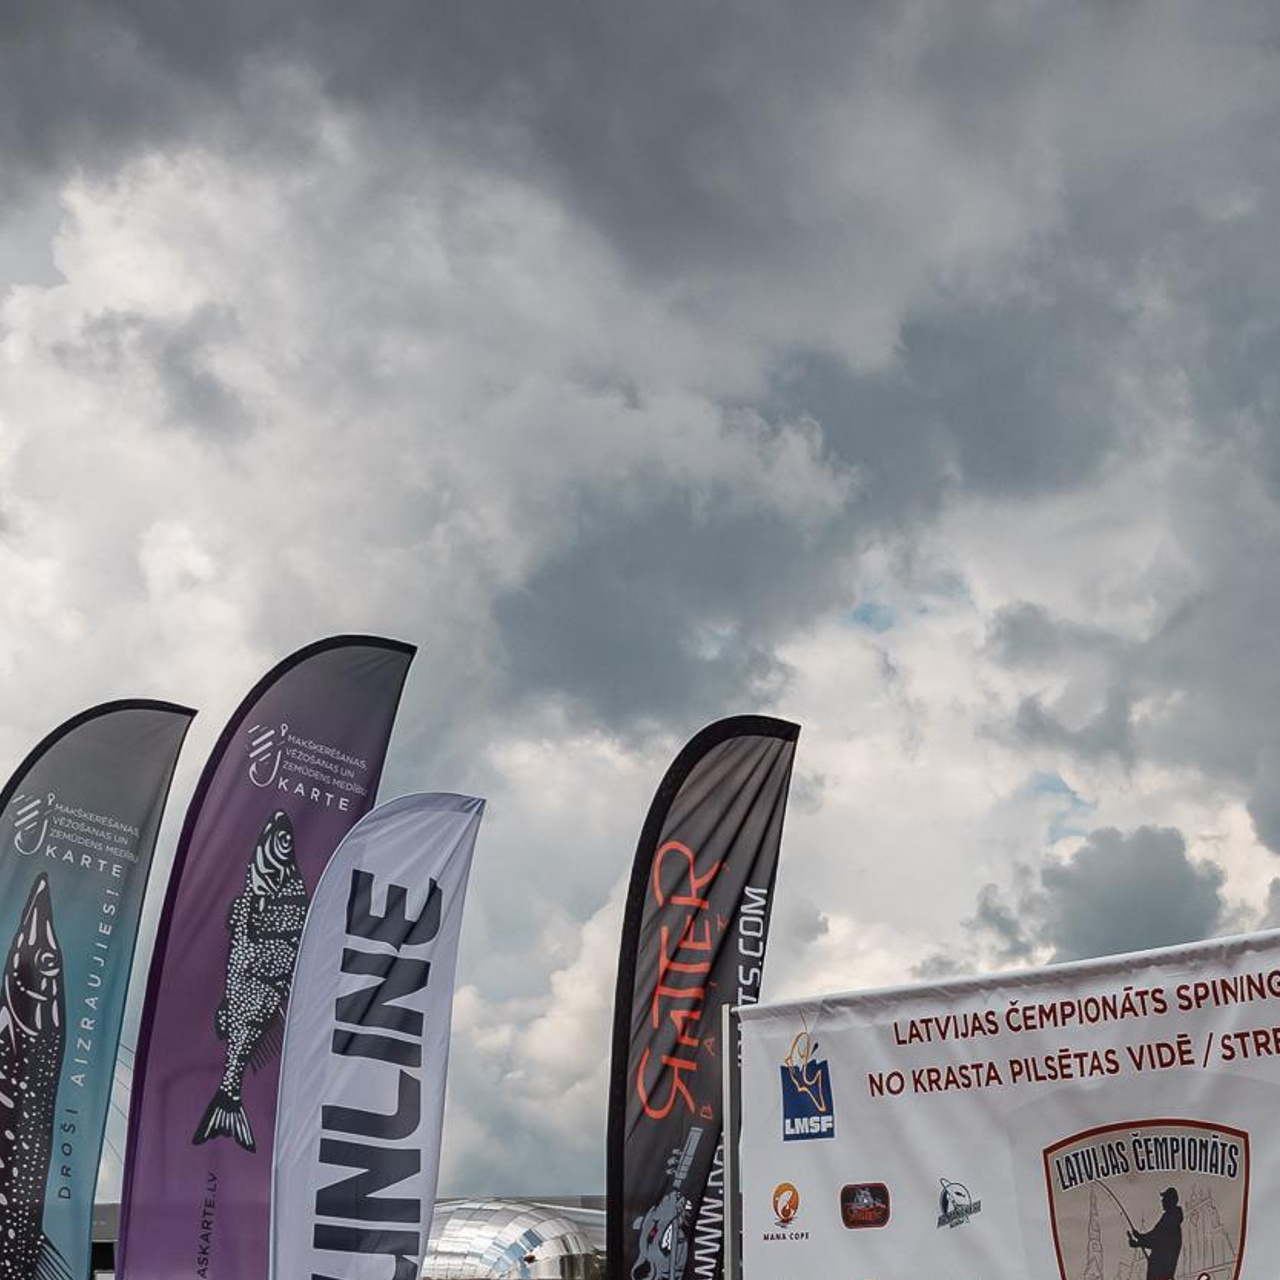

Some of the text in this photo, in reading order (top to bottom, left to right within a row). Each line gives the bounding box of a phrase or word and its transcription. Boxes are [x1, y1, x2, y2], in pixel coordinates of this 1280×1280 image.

[278, 777, 350, 811] KARTE
[45, 844, 123, 878] KARTE
[58, 887, 120, 1200] DROŠI AIZRAUJIES!
[893, 1007, 1000, 1047] LATVIJAS
[1004, 985, 1170, 1034] ČEMPIONĀTS
[868, 1071, 907, 1098] NO
[911, 1062, 1003, 1094] KRASTA
[1009, 1048, 1121, 1086] PILSĒTAS
[1126, 1034, 1196, 1074] VIDĒ
[784, 1115, 834, 1136] LMSF
[1056, 1133, 1239, 1190] LATVIJAS ČEMPIONĀTS
